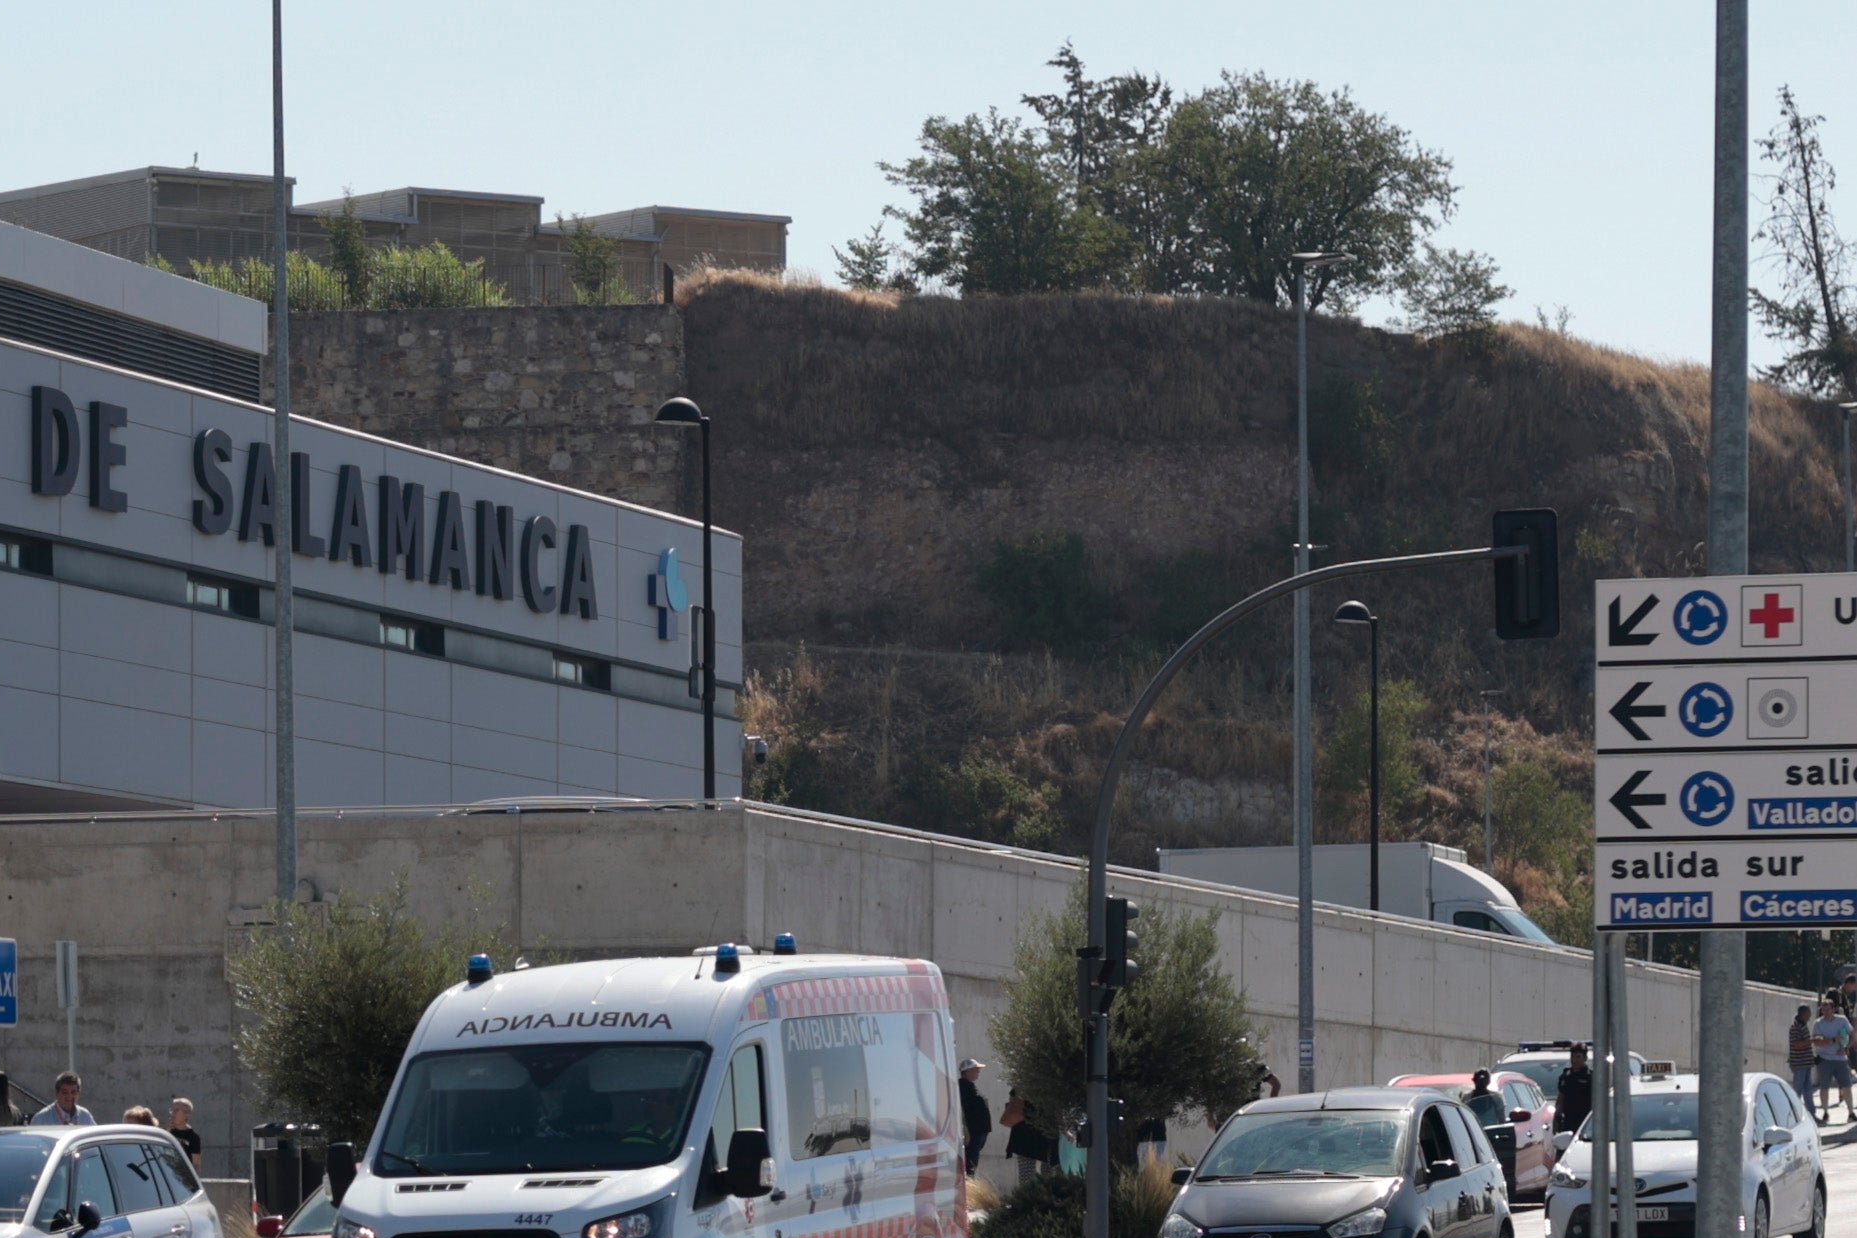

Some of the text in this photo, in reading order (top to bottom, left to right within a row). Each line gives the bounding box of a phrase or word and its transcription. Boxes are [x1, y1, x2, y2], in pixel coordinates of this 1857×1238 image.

[30, 384, 128, 513] DE
[192, 427, 599, 621] SALAMANCA
[1786, 758, 1857, 787] sali
[1611, 851, 1804, 879] salida sur
[1614, 894, 1855, 919] Madrid Cáceres
[787, 1015, 883, 1051] AMBULANCIA
[514, 1214, 553, 1226] 4447
[1645, 1209, 1666, 1219] LDX
